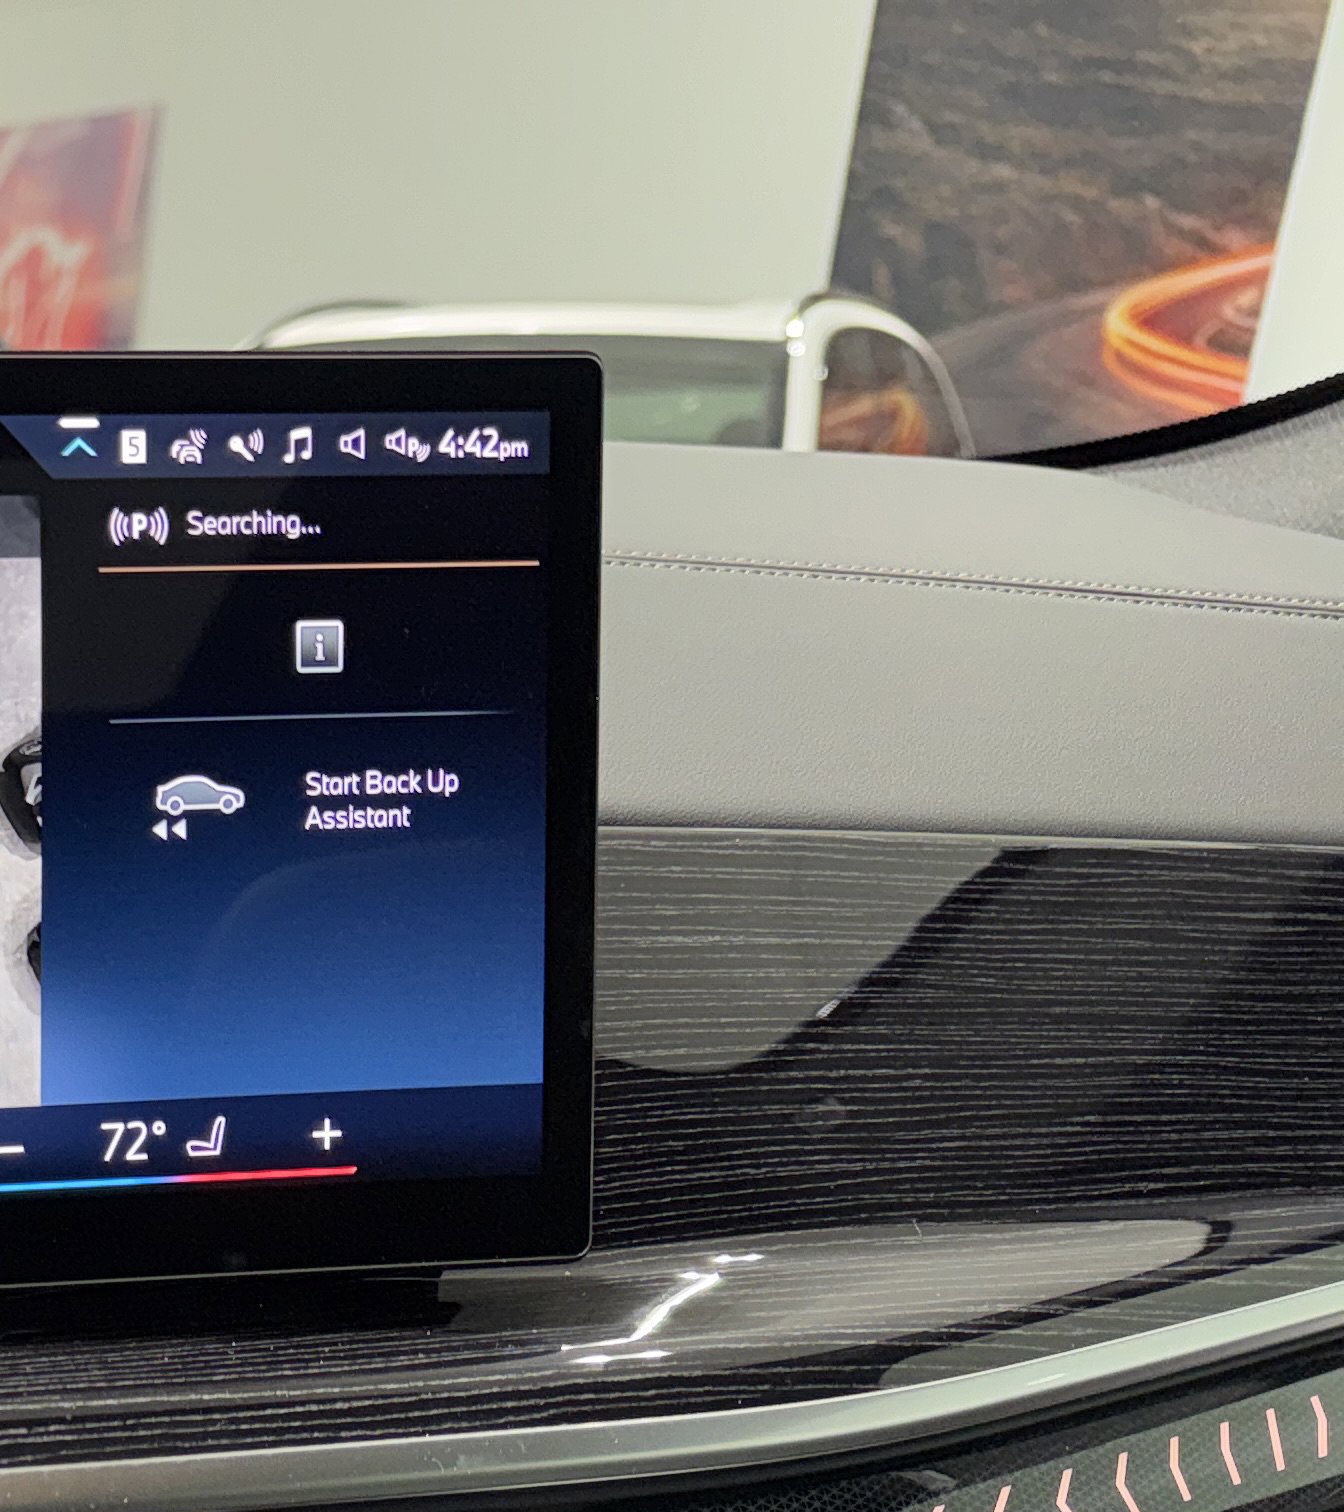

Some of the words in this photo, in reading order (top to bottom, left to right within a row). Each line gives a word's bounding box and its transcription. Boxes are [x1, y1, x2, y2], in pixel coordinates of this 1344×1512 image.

[438, 426, 529, 461] 4:42pm
[185, 509, 322, 541] Searching...
[304, 771, 360, 797] Start
[365, 769, 422, 796] Back
[426, 768, 461, 798] Up
[303, 803, 412, 831] Assistant
[100, 1119, 168, 1163] 72°
